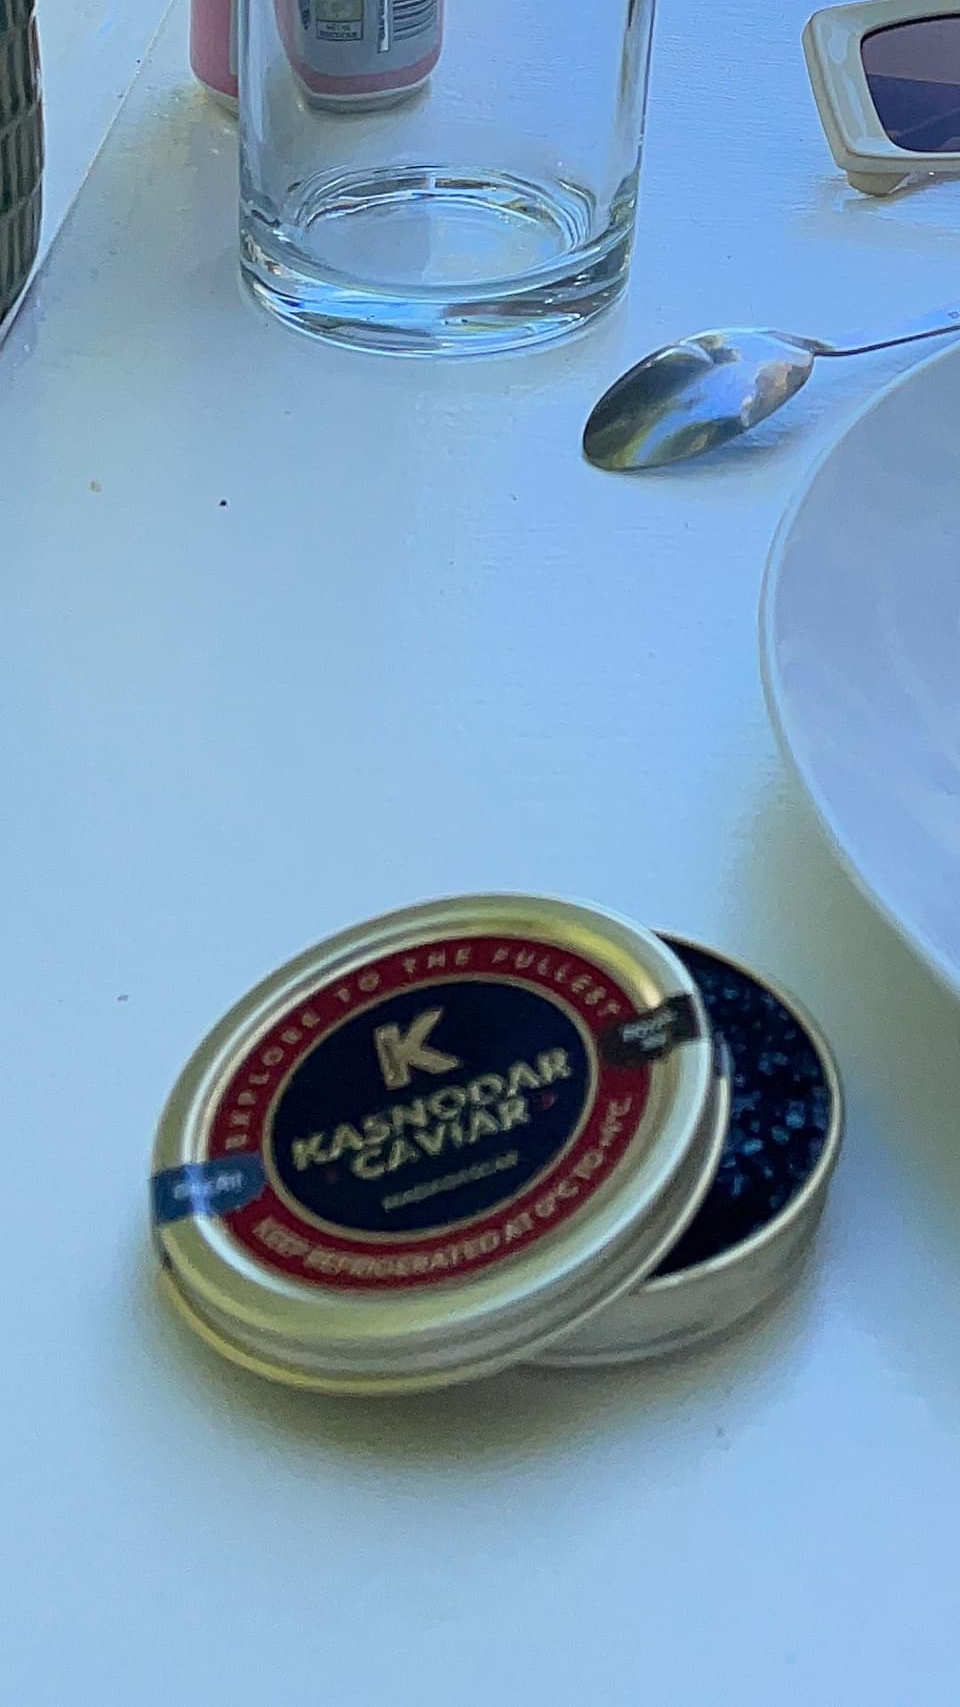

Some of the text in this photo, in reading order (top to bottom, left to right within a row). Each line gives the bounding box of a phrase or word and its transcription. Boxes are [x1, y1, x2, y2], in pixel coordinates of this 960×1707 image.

[225, 946, 622, 1151] EXPLORE TO THE FULLEST
[374, 1005, 464, 1091] K
[290, 1046, 573, 1173] KASNODAR
[351, 1096, 531, 1181] CAVIAR
